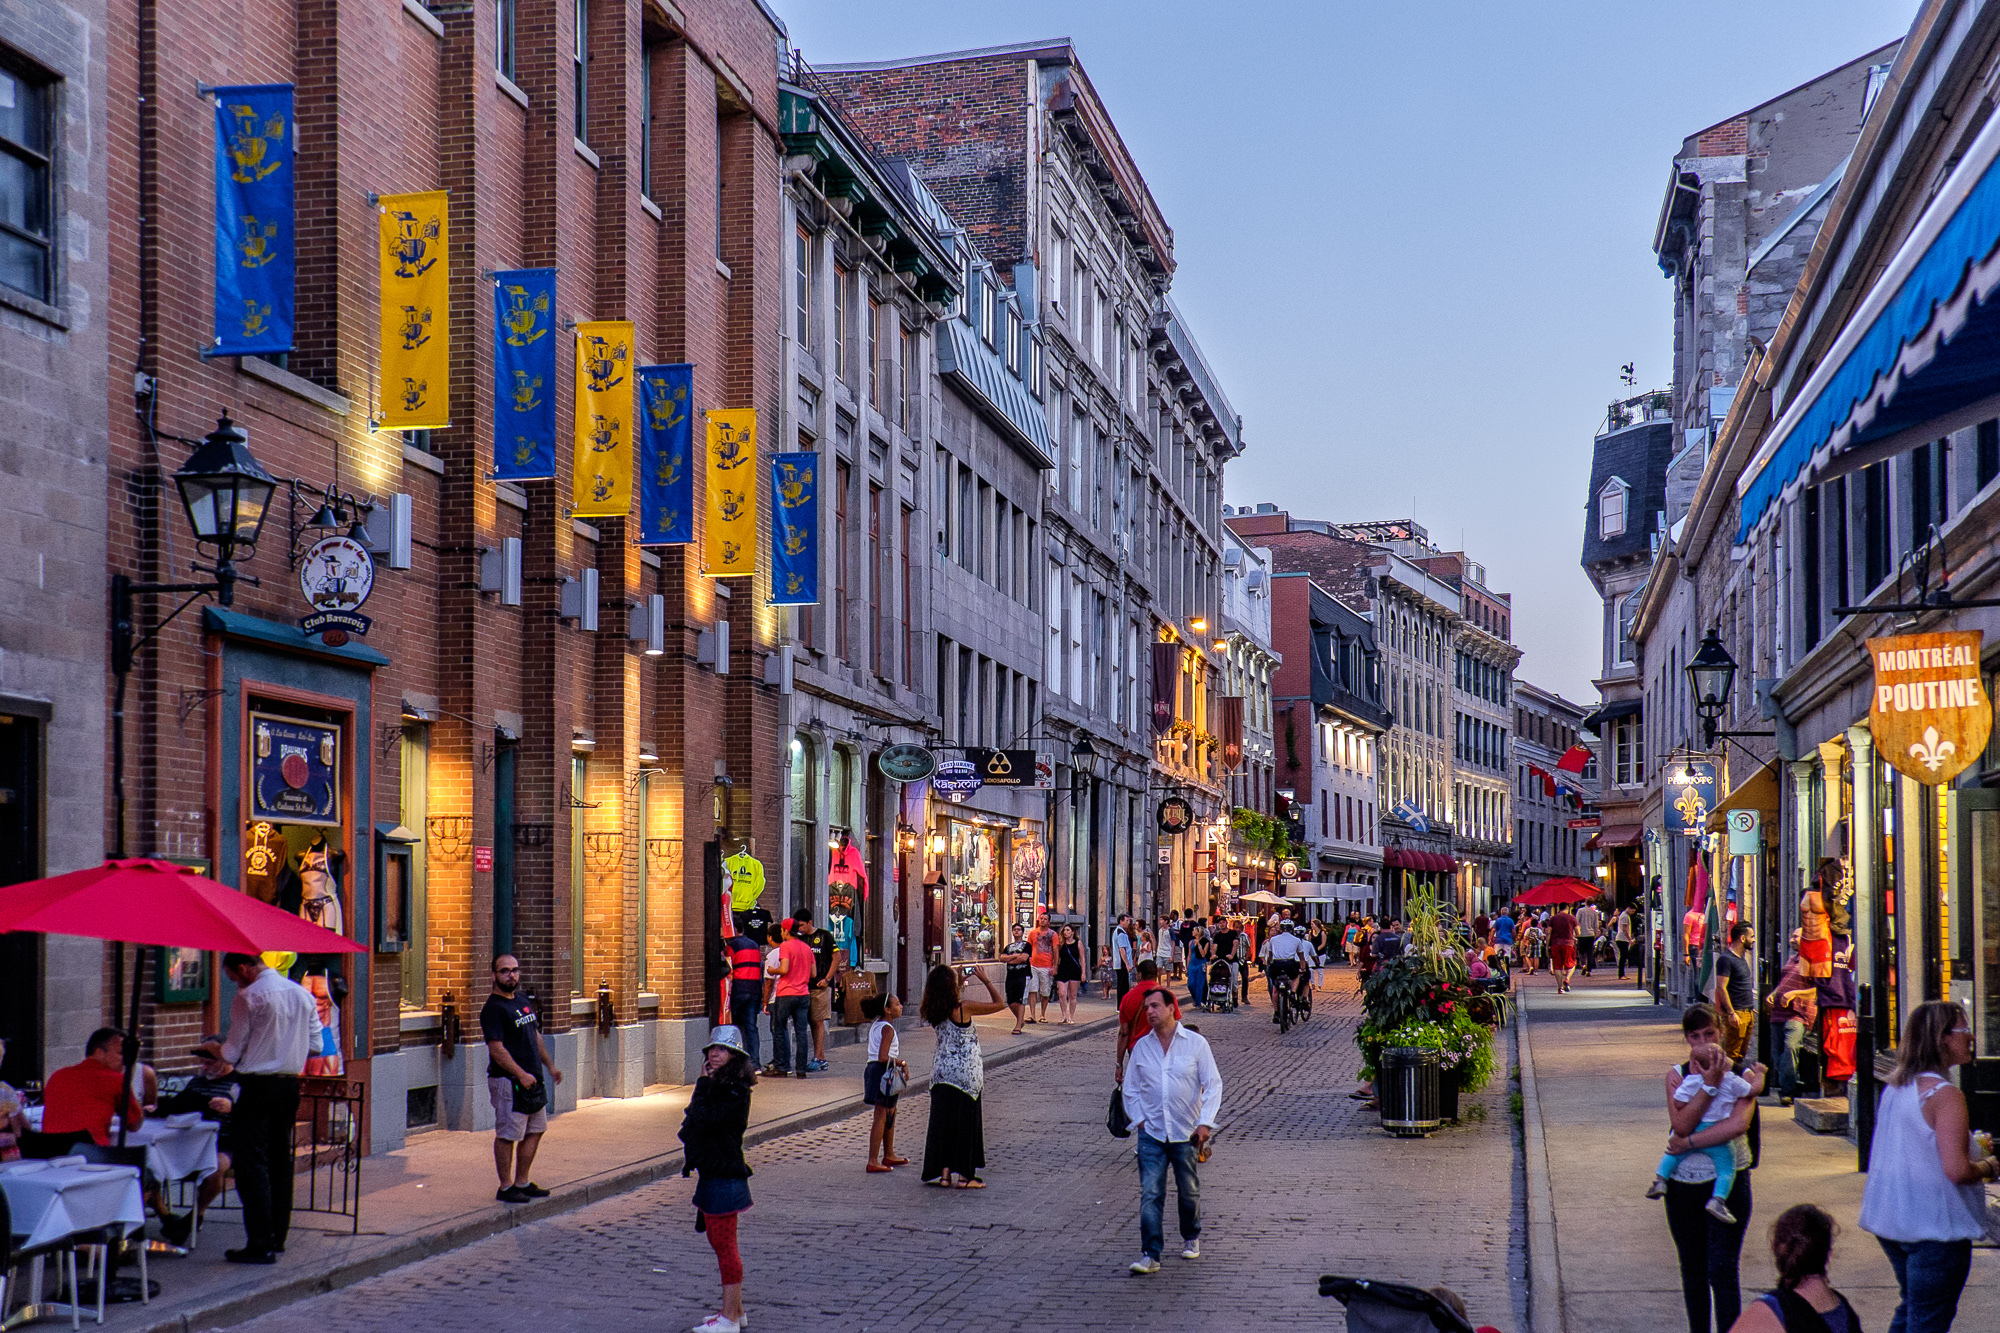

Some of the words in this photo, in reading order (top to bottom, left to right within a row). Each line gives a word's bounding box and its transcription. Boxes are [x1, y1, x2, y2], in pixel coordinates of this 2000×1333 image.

[304, 614, 325, 629] Club
[326, 613, 366, 629] Bavarois
[1879, 643, 1975, 672] MONTRÉAL
[1878, 678, 1980, 713] POUTINE
[940, 761, 973, 769] RESTURANT
